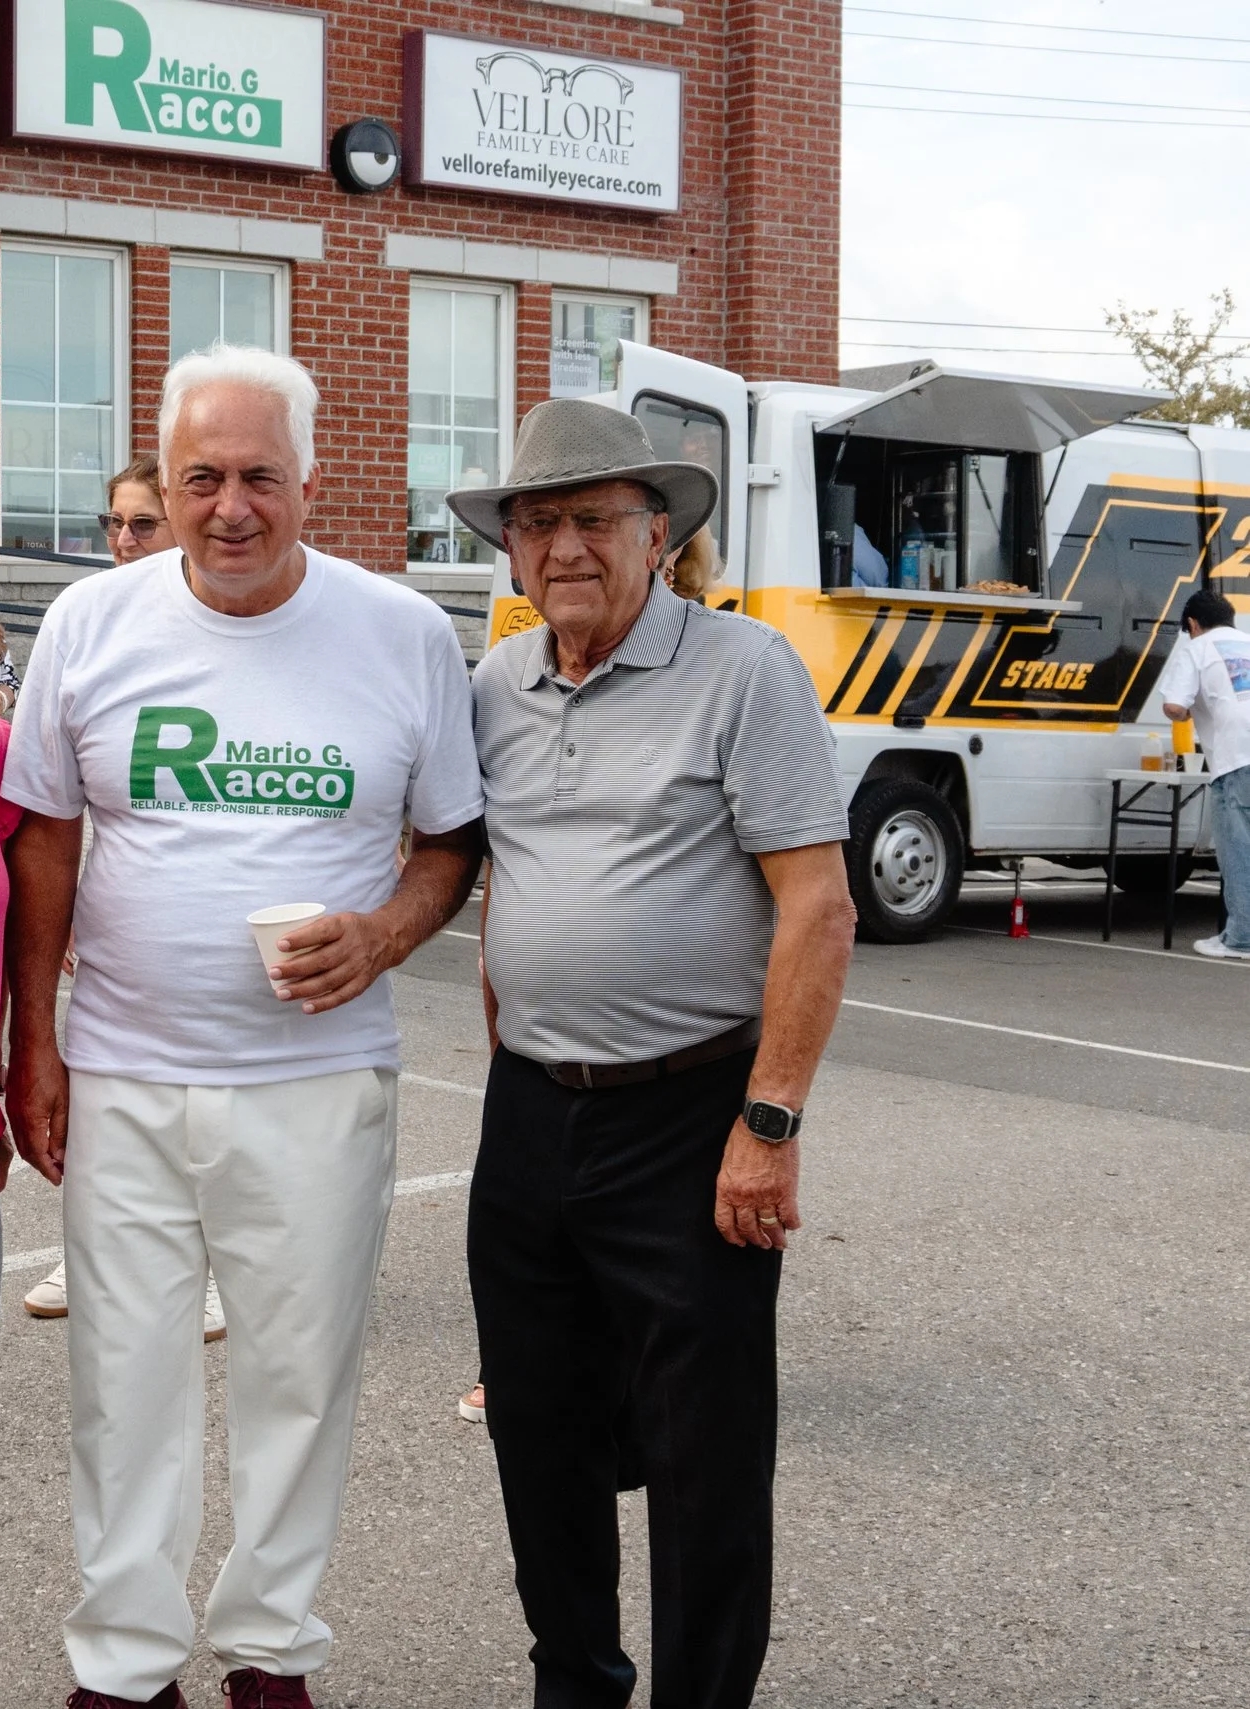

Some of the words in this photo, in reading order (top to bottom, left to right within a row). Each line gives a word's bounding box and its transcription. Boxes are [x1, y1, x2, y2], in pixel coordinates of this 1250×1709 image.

[240, 68, 259, 95] G
[472, 87, 635, 148] VELLORE
[477, 130, 543, 154] FAMILY
[549, 140, 580, 160] EYE
[586, 145, 630, 166] CARE
[442, 153, 662, 197] vellorefamilyeyecare.com
[1000, 660, 1095, 691] STAGE
[226, 740, 312, 764] Mario
[322, 744, 351, 768] G.
[131, 800, 189, 812] RELIABLE.
[192, 803, 274, 816] RESPONSIBLE.
[277, 807, 348, 819] RESPONSIVE.
